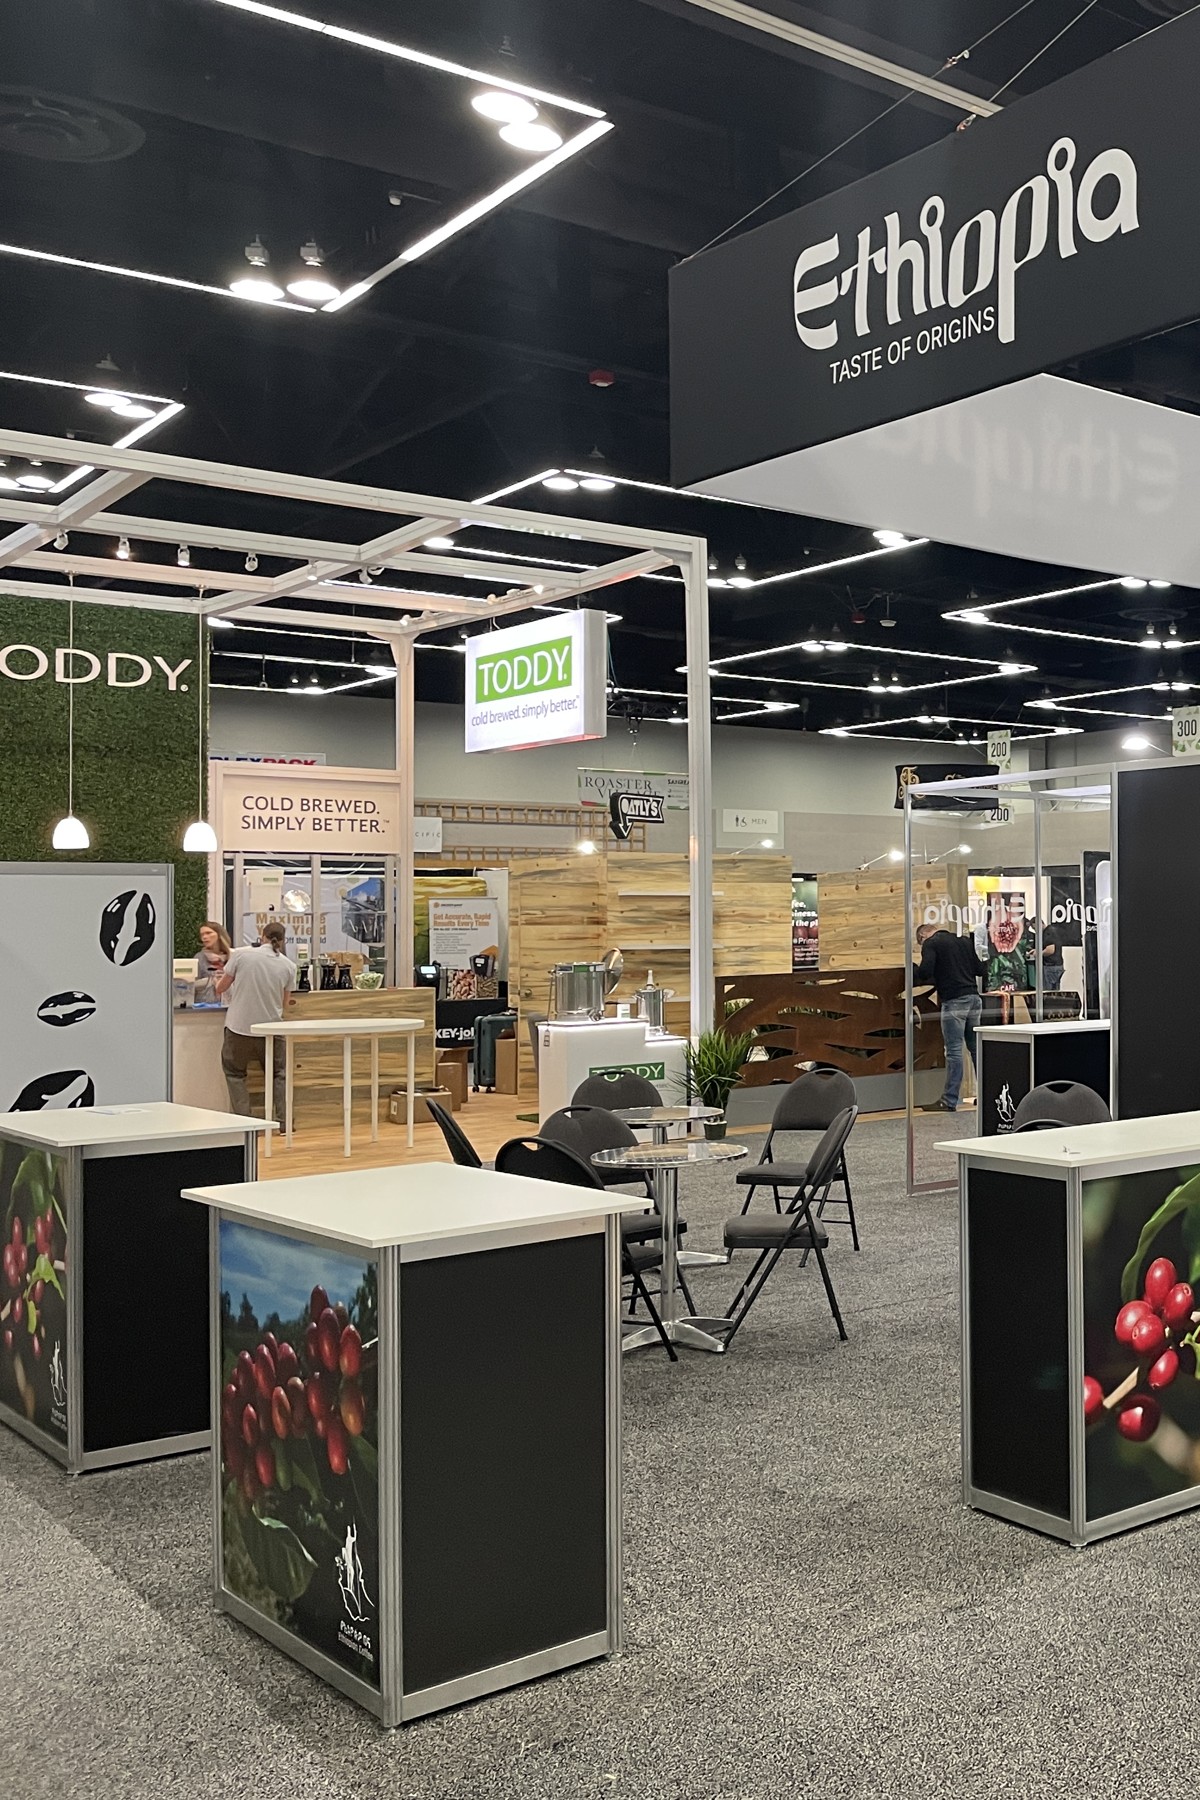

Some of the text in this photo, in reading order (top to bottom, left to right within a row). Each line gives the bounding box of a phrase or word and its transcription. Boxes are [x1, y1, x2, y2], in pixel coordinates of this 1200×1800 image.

[794, 137, 1139, 349] Ethiopia
[829, 306, 995, 384] TASTE OF ORIGINS
[471, 711, 488, 726] cold
[489, 705, 520, 724] brewed.
[522, 701, 549, 719] simply
[1177, 719, 1197, 737] 300
[991, 741, 1007, 757] 200
[585, 777, 652, 790] ROASTER
[242, 795, 380, 815] COLD BREWED.
[621, 798, 658, 816] OATLY'S
[241, 815, 305, 830] SIMPLY
[990, 808, 1009, 822] 200
[256, 912, 326, 924] Maximie
[292, 925, 326, 935] Yied
